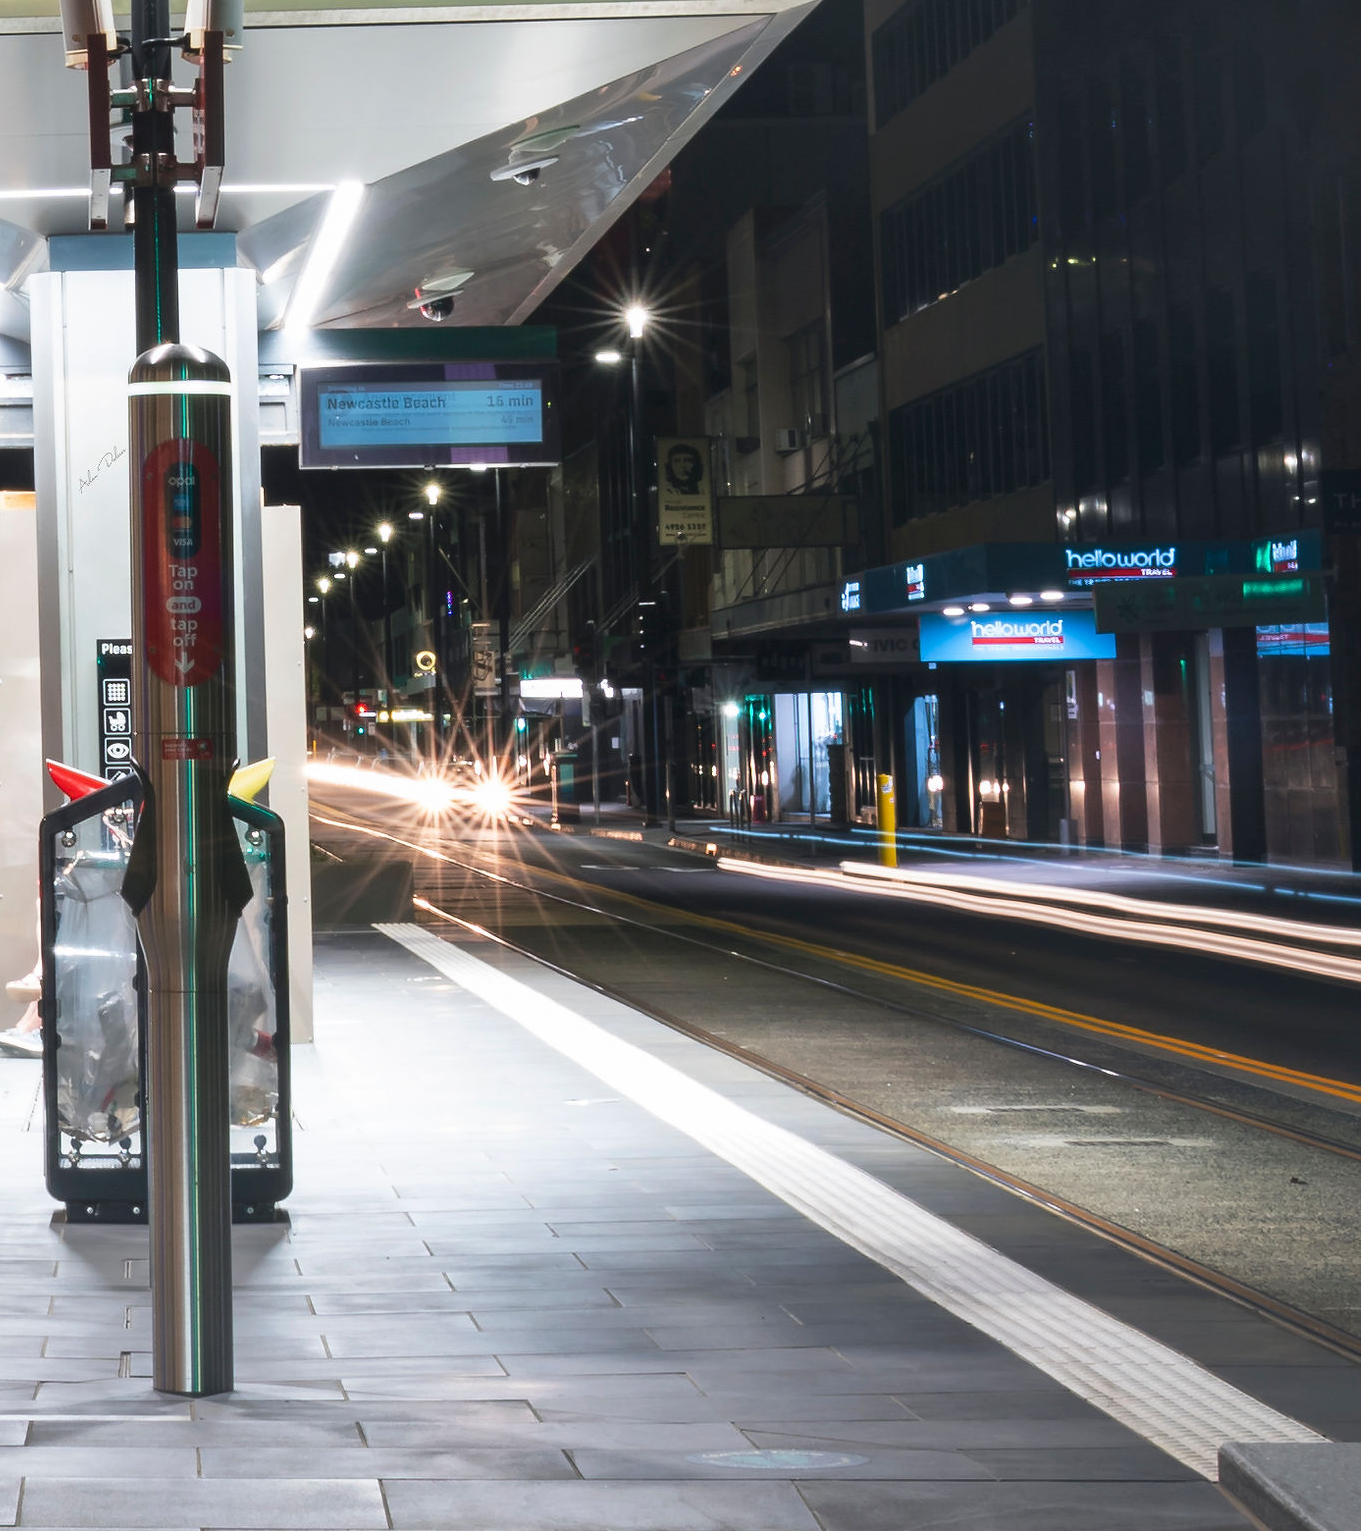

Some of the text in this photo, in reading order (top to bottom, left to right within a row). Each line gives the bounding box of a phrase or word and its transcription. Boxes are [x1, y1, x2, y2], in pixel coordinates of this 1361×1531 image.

[328, 396, 399, 410] Newcastle
[404, 396, 446, 409] Beach
[508, 394, 534, 407] min
[329, 417, 378, 427] Newcastle
[381, 416, 410, 426] Beach
[168, 476, 196, 488] opal
[173, 538, 194, 546] VISA
[1066, 548, 1176, 568] helloworld
[168, 564, 198, 579] Tap
[173, 580, 194, 590] on
[171, 599, 196, 610] and
[170, 618, 198, 633] tap
[971, 620, 1064, 637] helloworld
[173, 633, 198, 647] off
